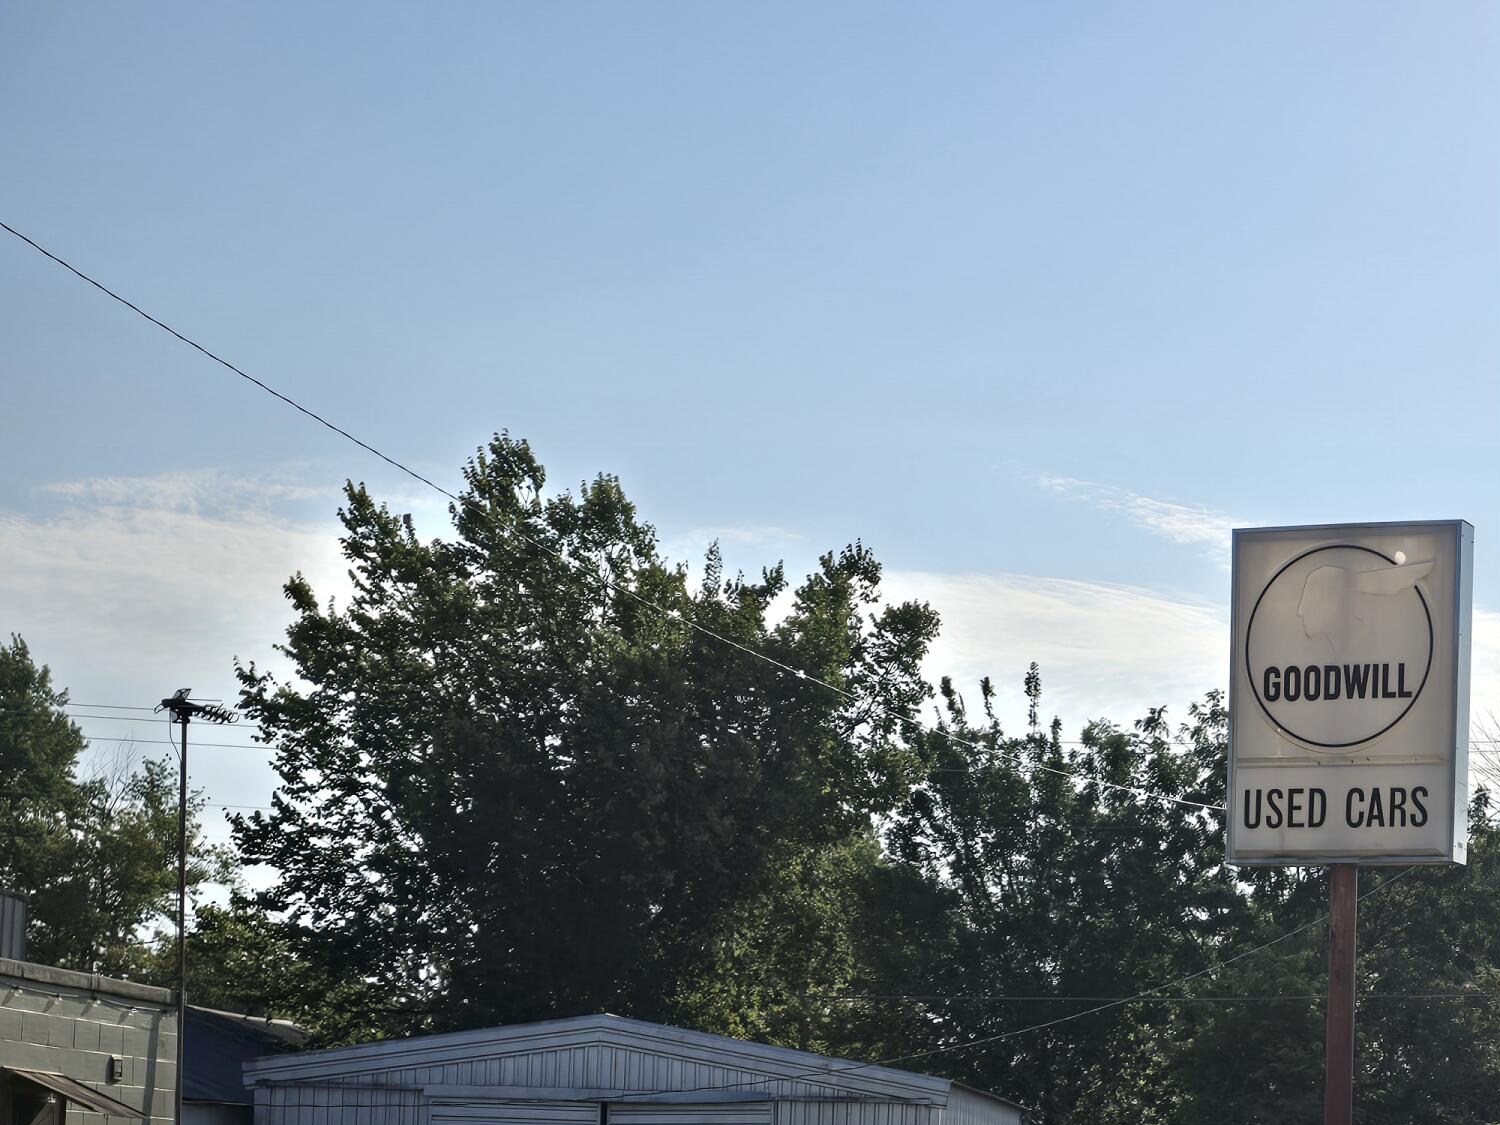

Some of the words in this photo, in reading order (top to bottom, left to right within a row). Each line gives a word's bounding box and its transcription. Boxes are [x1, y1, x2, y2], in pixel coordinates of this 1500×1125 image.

[1263, 663, 1413, 702] GOODWILL
[1243, 788, 1327, 829] USED
[1345, 786, 1429, 828] CARS
